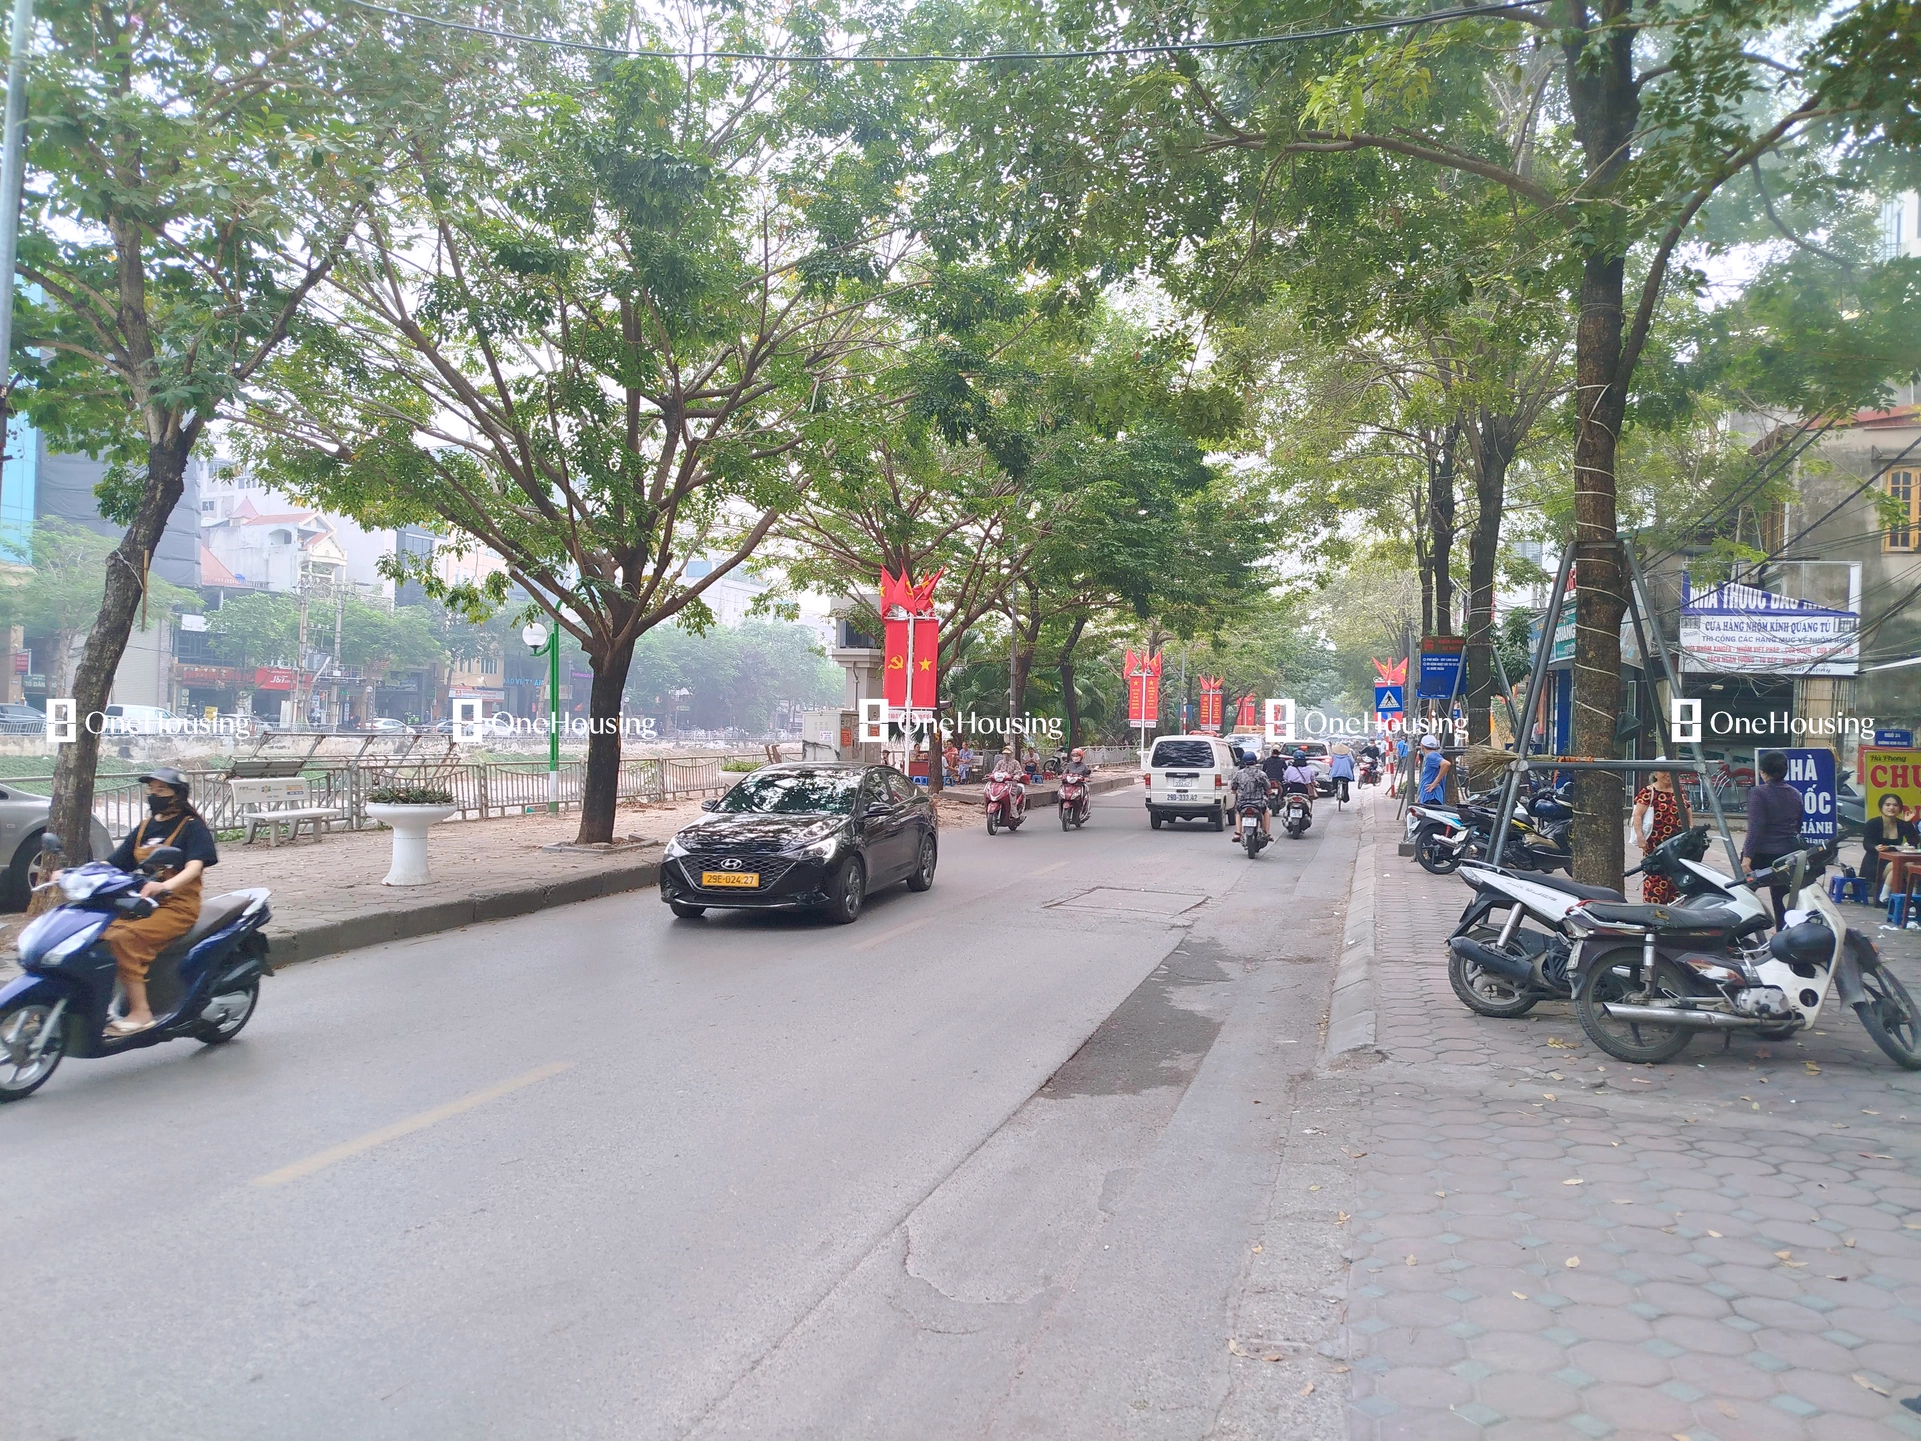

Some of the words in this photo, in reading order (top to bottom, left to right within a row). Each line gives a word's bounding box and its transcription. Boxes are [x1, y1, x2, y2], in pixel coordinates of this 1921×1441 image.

[1705, 618, 1721, 632] CỬA
[1723, 618, 1744, 632] HÀNG
[1769, 619, 1789, 632] KÍNH
[1790, 622, 1818, 634] QUANG
[1820, 620, 1831, 632] TÚ
[1716, 634, 1736, 642] CÔNG
[1738, 634, 1754, 643] CÁC
[270, 675, 288, 684] J&T
[1883, 755, 1907, 763] Phong
[707, 874, 755, 885] 29E-024.27
